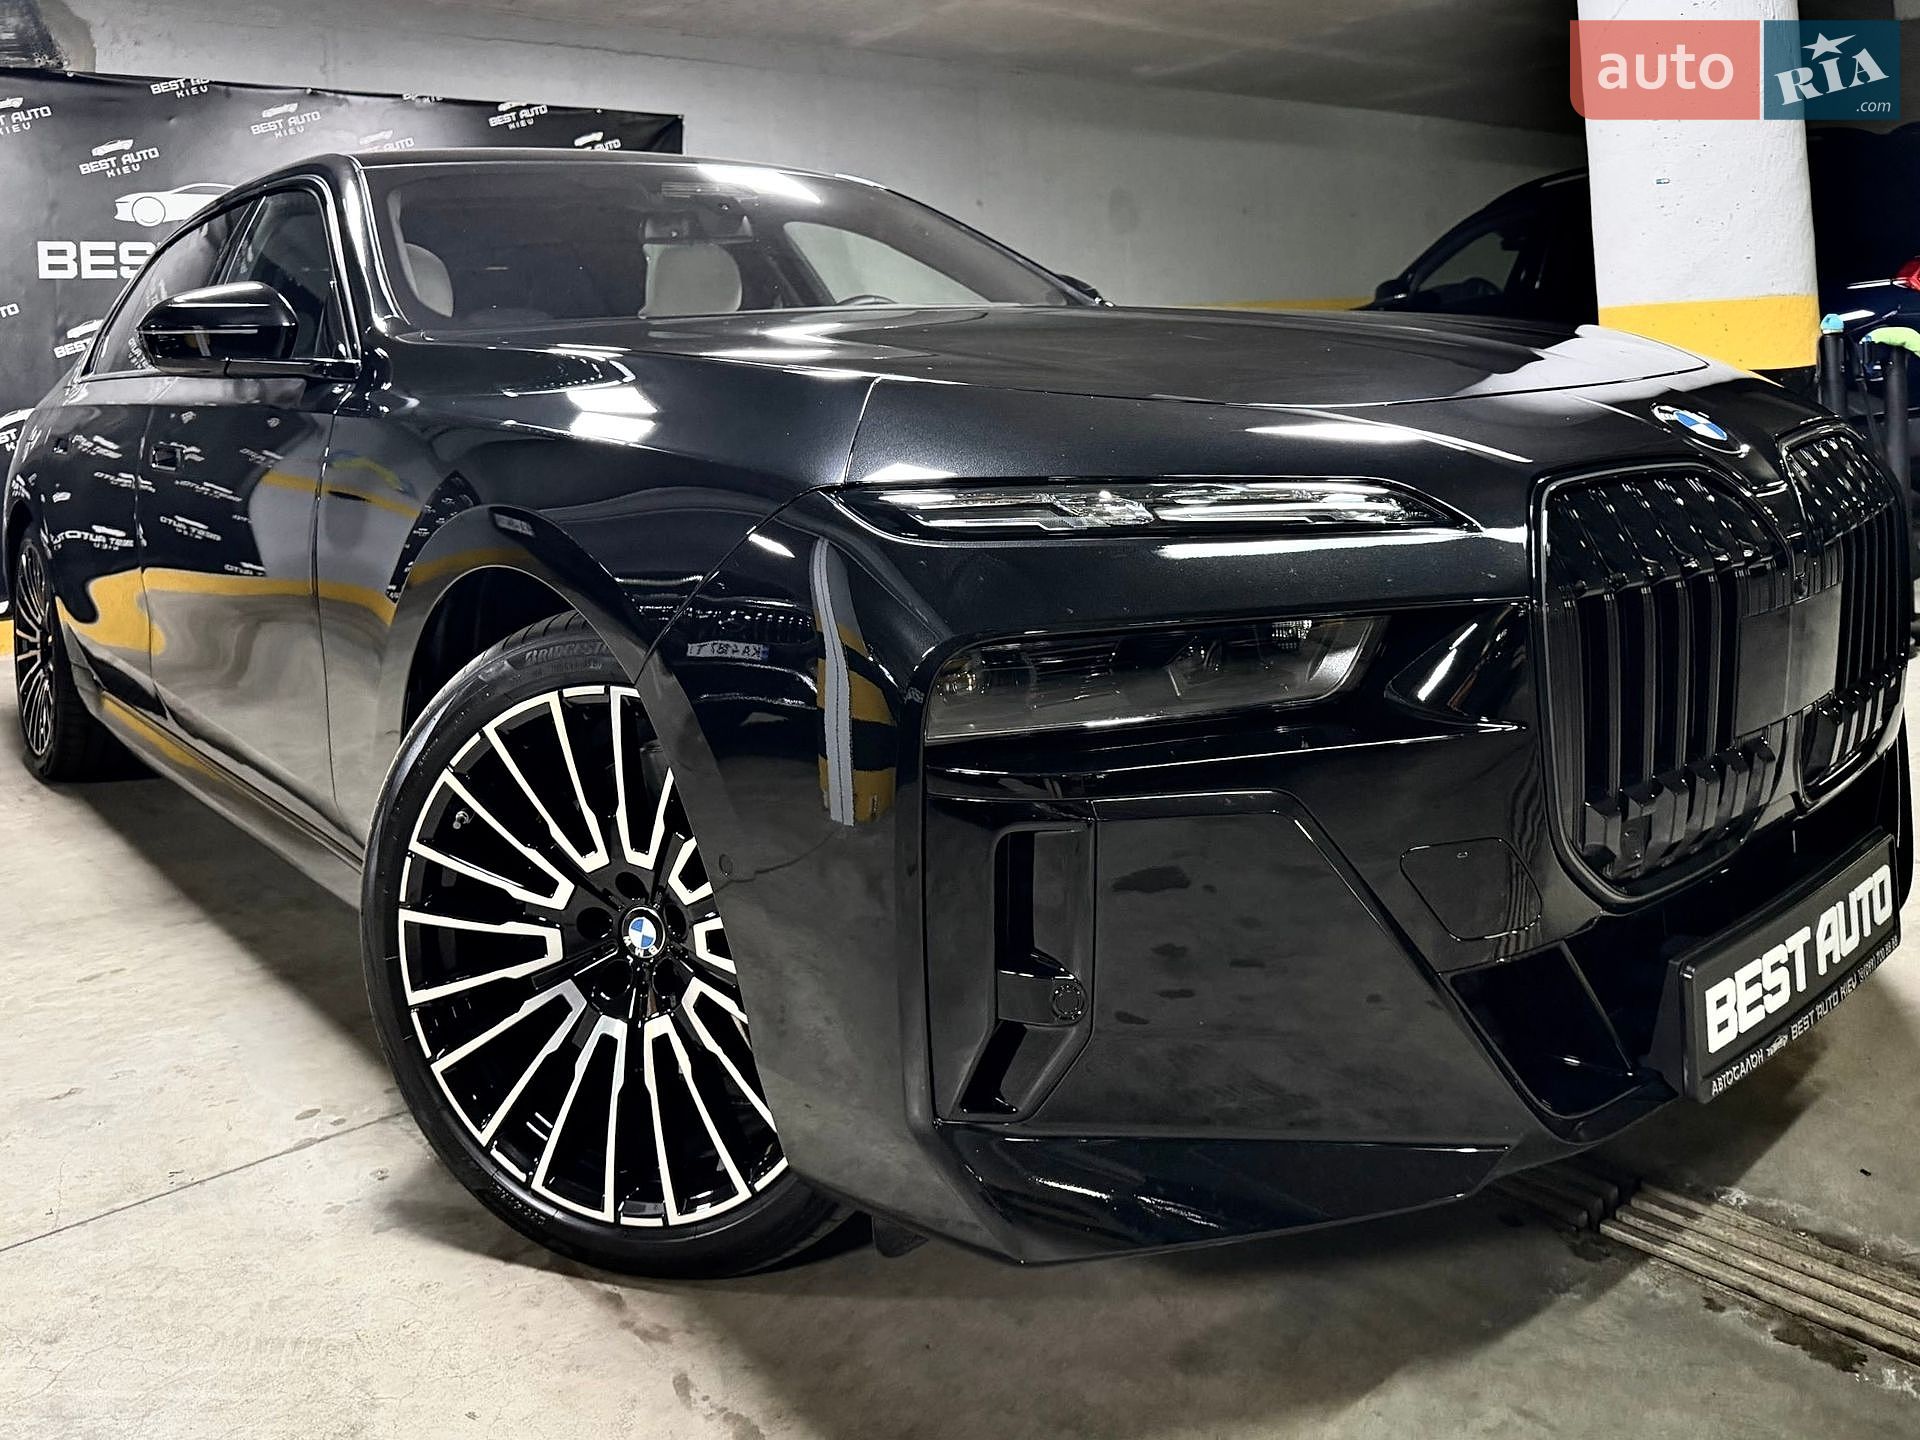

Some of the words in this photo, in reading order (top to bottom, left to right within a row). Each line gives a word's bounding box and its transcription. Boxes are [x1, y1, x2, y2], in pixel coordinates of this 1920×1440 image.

[150, 79, 185, 94] BEST
[11, 106, 52, 123] AUTO
[250, 118, 285, 135] BEST
[287, 111, 321, 127] AUTO
[488, 112, 517, 127] BEST
[519, 105, 548, 119] AUTO
[79, 157, 118, 175] BEST
[121, 147, 160, 165] AUTO
[37, 240, 157, 279] BES
[0, 303, 20, 318] TO
[1704, 926, 1811, 1054] BEST
[1815, 864, 1893, 976] AUTO
[1790, 1009, 1815, 1041] BEST
[1815, 990, 1839, 1021] AUTO
[1711, 1048, 1764, 1097] АВТОСАЛОН
